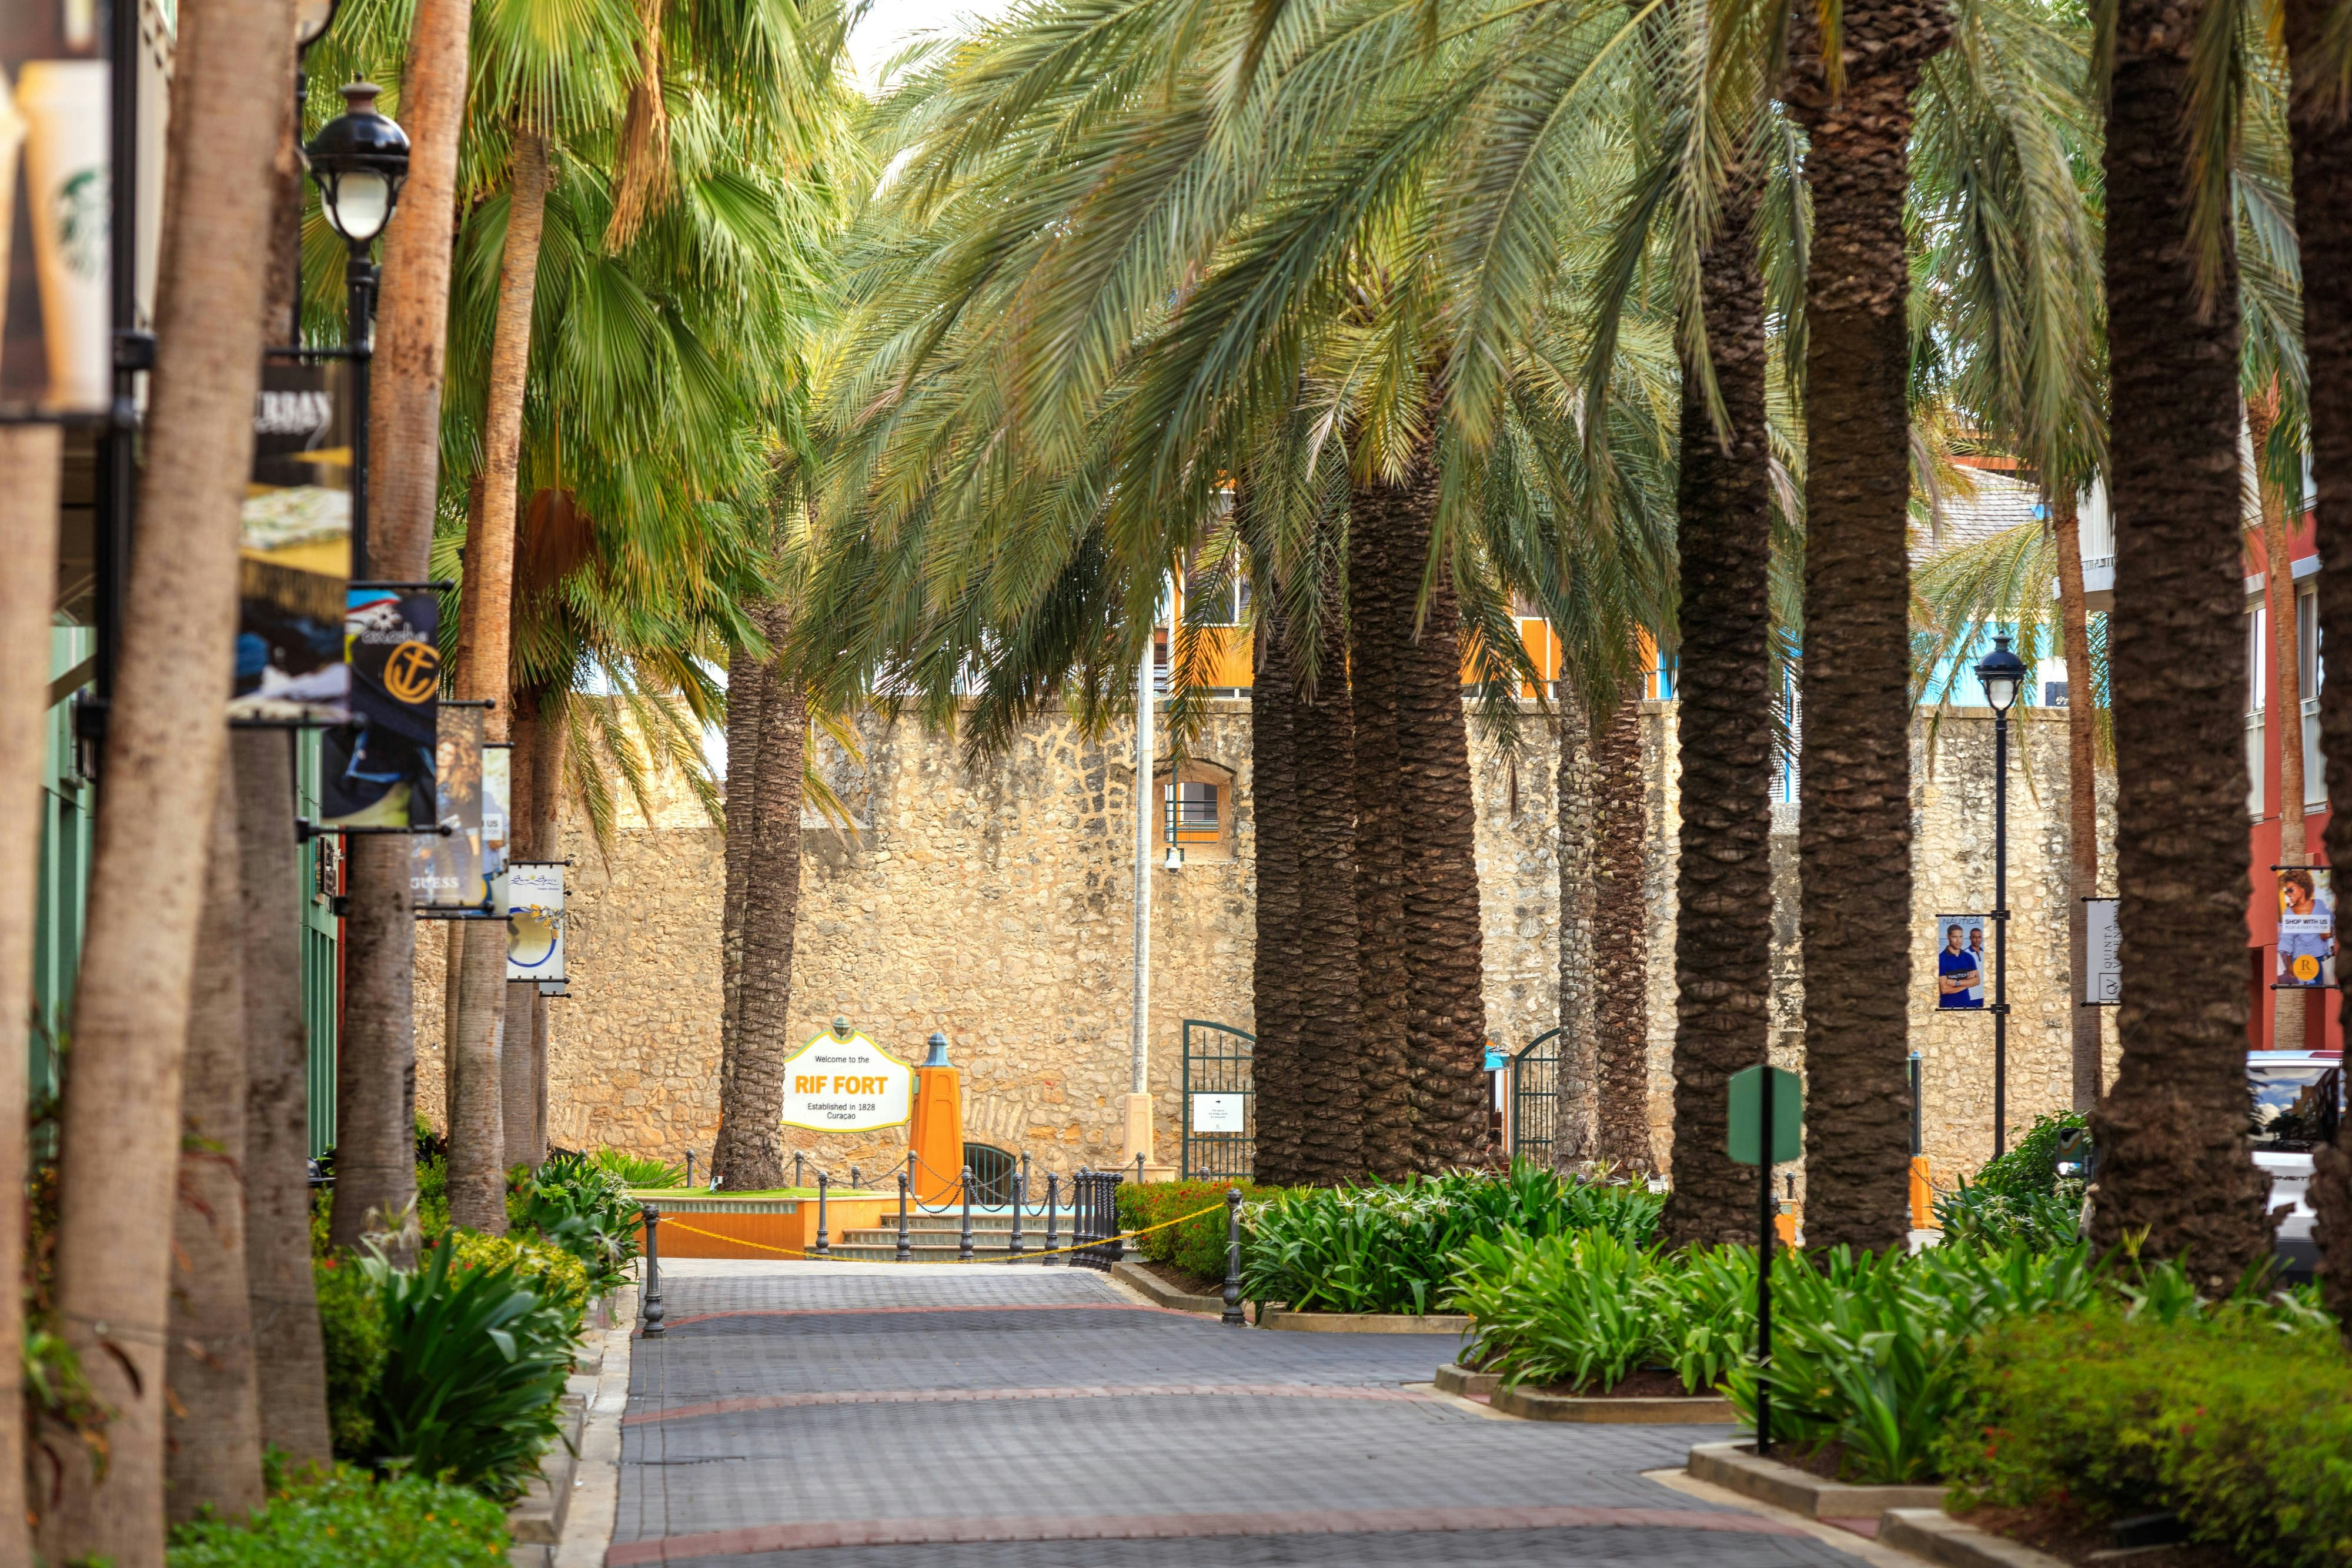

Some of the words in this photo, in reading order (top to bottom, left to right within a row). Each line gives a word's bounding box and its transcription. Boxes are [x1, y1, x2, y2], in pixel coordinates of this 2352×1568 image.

[410, 877, 459, 889] GUESS
[795, 1075, 827, 1094] RIF
[834, 1076, 888, 1095] FORT
